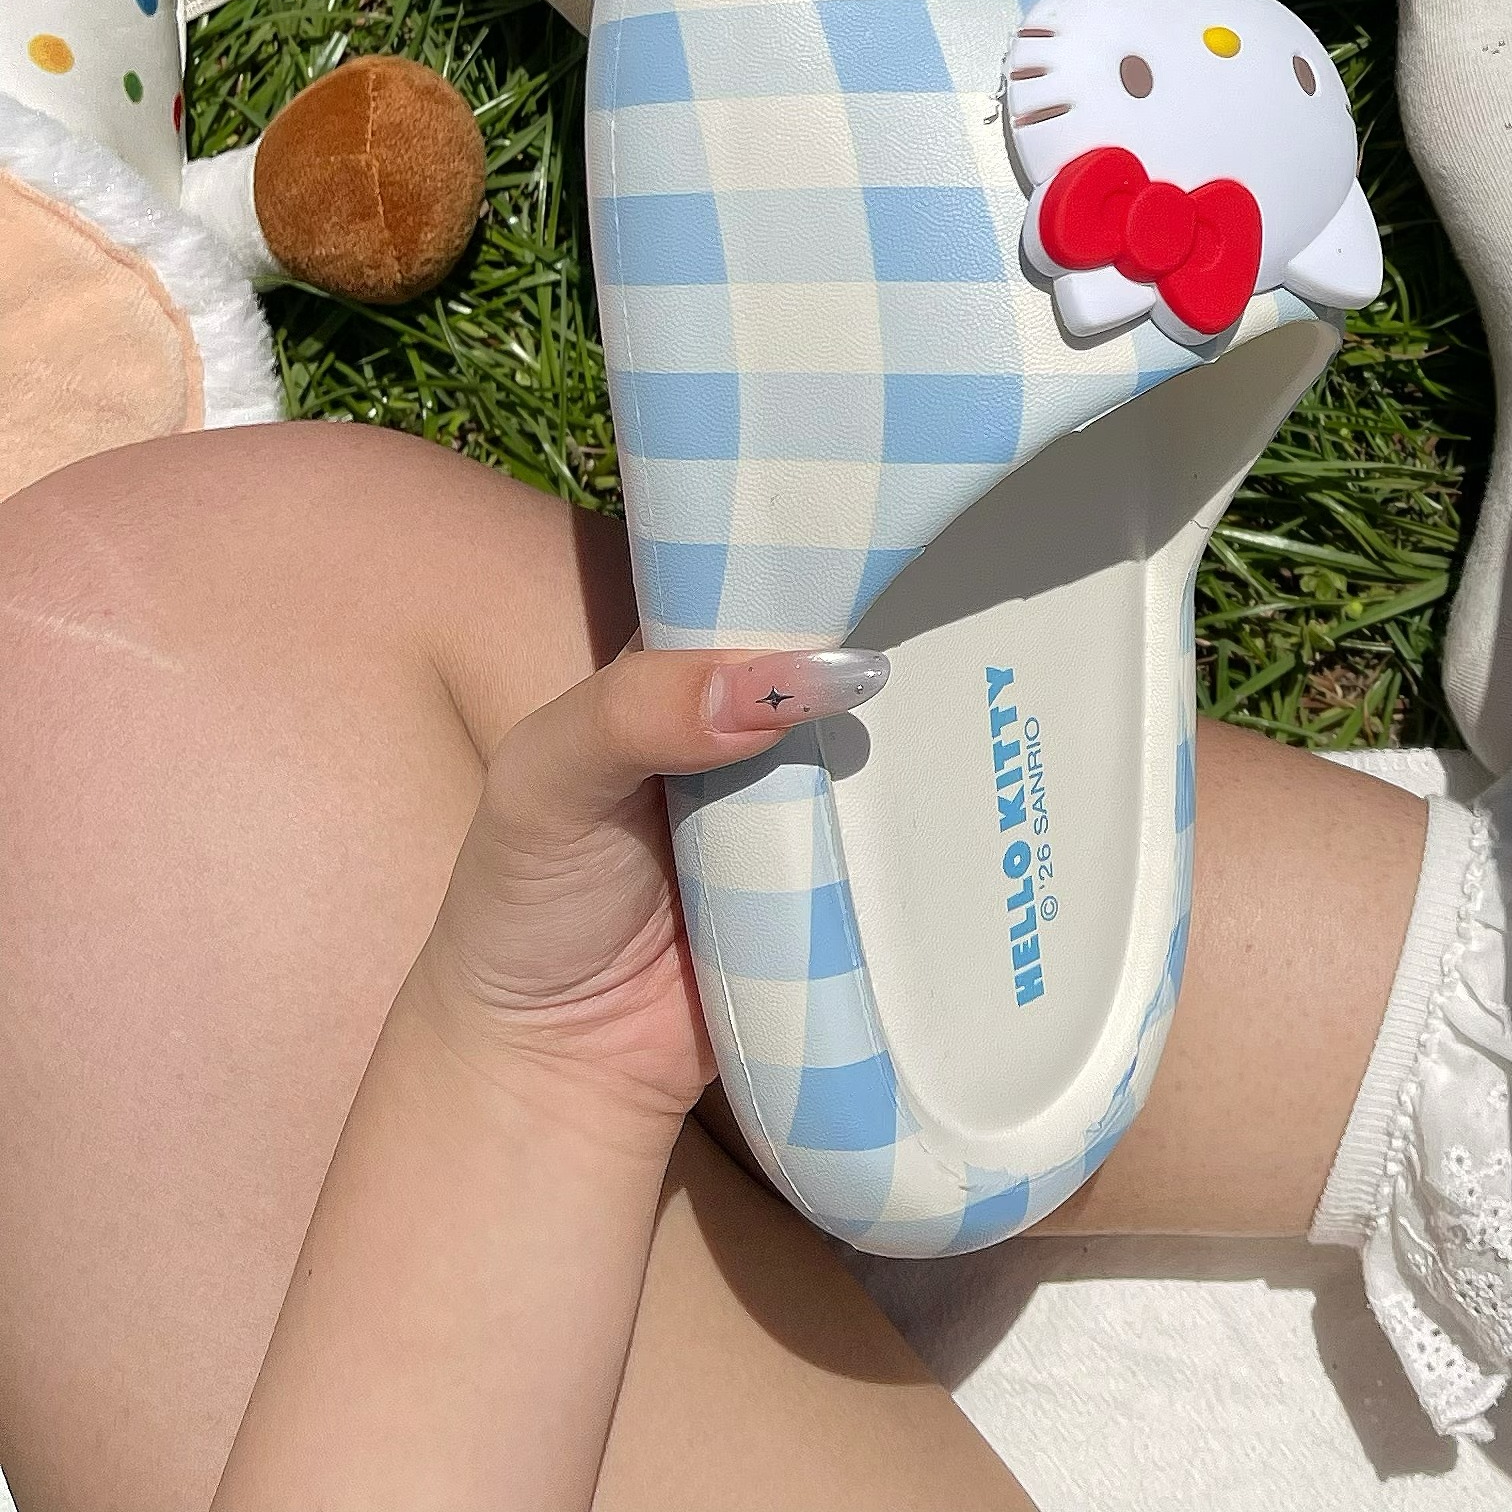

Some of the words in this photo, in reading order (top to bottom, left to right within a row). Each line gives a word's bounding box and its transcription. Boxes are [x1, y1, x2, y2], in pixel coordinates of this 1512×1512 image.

[985, 666, 1027, 833] KITTY
[1023, 716, 1049, 836] SANRIO
[1002, 840, 1046, 1007] HELLO
